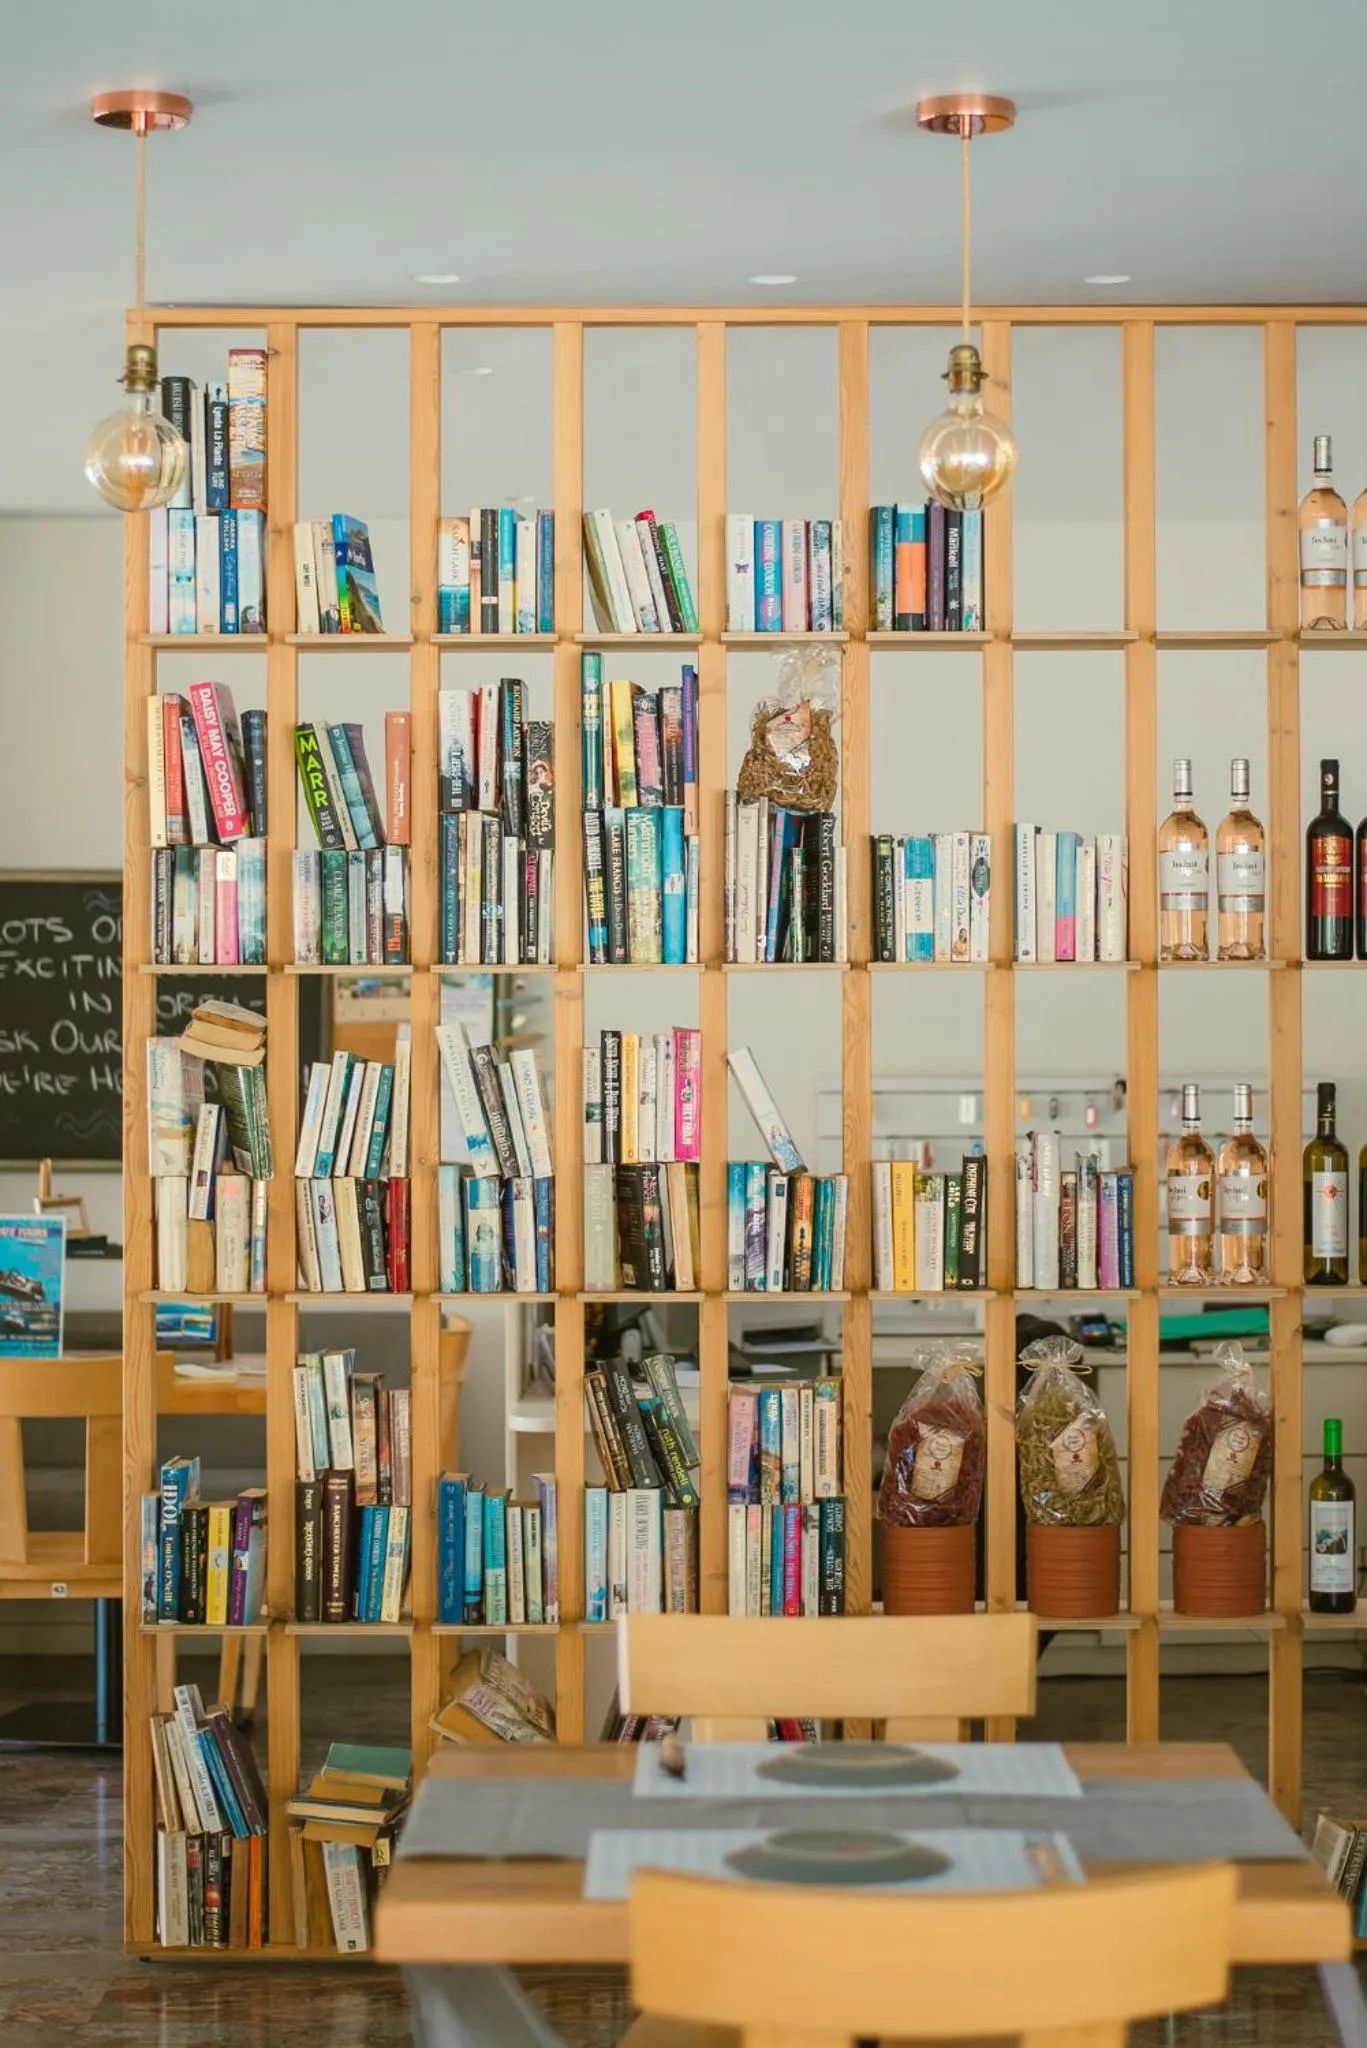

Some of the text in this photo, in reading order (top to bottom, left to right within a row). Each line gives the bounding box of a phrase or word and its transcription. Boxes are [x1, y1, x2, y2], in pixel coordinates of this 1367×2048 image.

[213, 406, 225, 429] Lynda
[213, 441, 225, 466] Plante
[948, 527, 959, 568] Mankell
[199, 687, 217, 726] DAISY
[513, 685, 521, 723] RICHARD
[207, 729, 225, 758] MAY
[300, 733, 329, 808] MARR
[213, 759, 237, 817] COOPER
[611, 825, 621, 854] CLARE
[612, 856, 622, 894] FRANCIS
[820, 818, 832, 911] Robert Goddard
[0, 914, 123, 945] OTS O
[0, 951, 123, 979] EXCITIN
[69, 990, 113, 1014] IN
[0, 1029, 40, 1054] SK
[642, 1170, 651, 1203] French
[649, 1175, 657, 1197] Nicci
[947, 1181, 956, 1208] CHILD
[963, 1162, 978, 1214] JOSEPHINE COX
[661, 1428, 688, 1486] ruth rendell
[164, 1536, 175, 1569] Louise
[331, 1504, 341, 1588] BARCHESTER TOWERS
[164, 1570, 174, 1602] O'Neill
